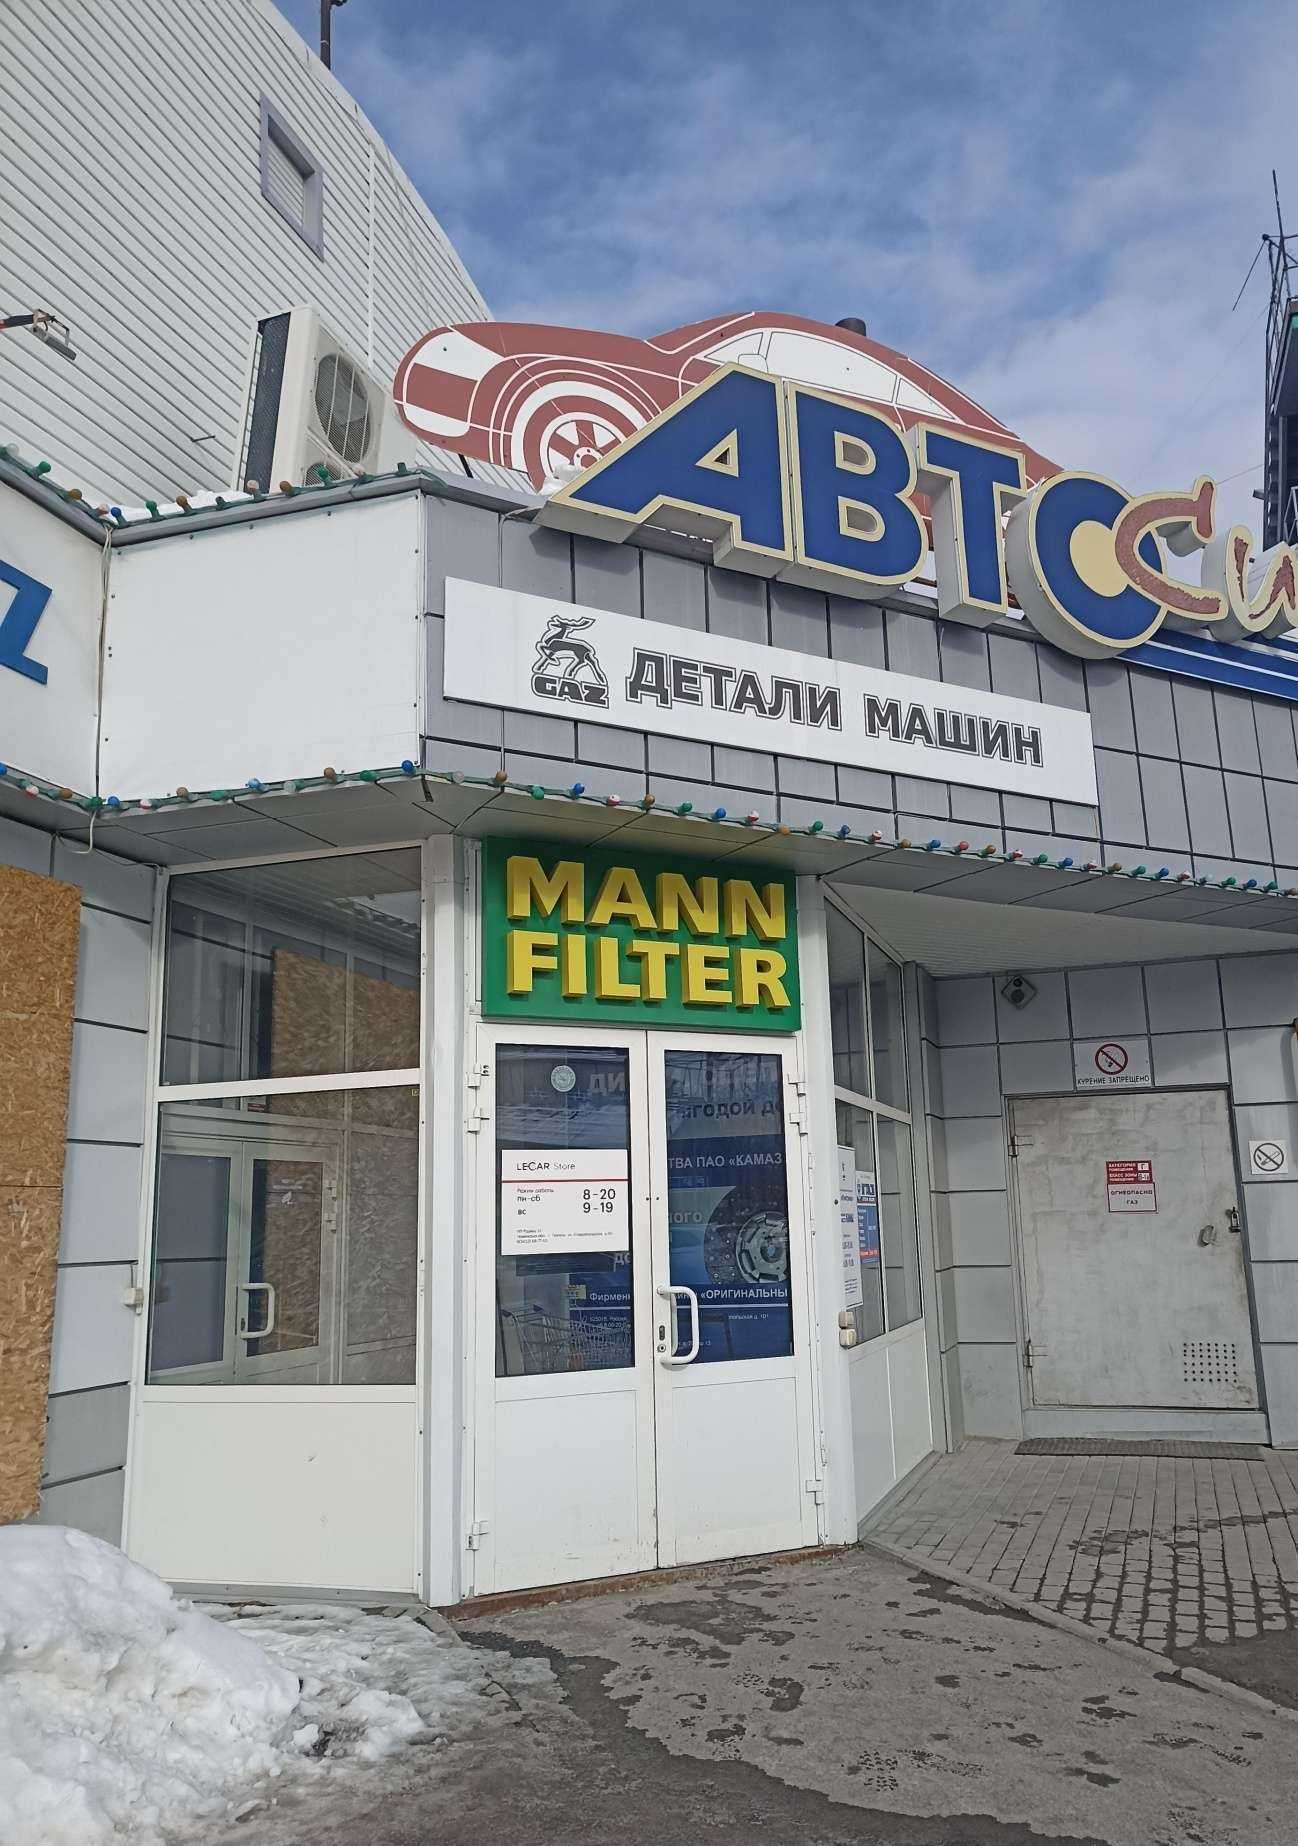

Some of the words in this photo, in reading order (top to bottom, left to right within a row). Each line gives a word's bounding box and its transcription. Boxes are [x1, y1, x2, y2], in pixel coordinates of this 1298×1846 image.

[540, 362, 1168, 655] АВТО
[531, 673, 609, 708] GAZ
[626, 647, 842, 731] ДЕТАЛИ
[865, 693, 1043, 768] МАШИН
[507, 856, 786, 940] MANN
[507, 929, 791, 1008] FILTER
[1077, 1077, 1106, 1086] КУРЕНИЕ
[1107, 1074, 1150, 1084] ЗАПРЕЩЕНО
[516, 1161, 550, 1171] LECAR
[553, 1162, 576, 1170] Store
[697, 1154, 725, 1168] ПАО
